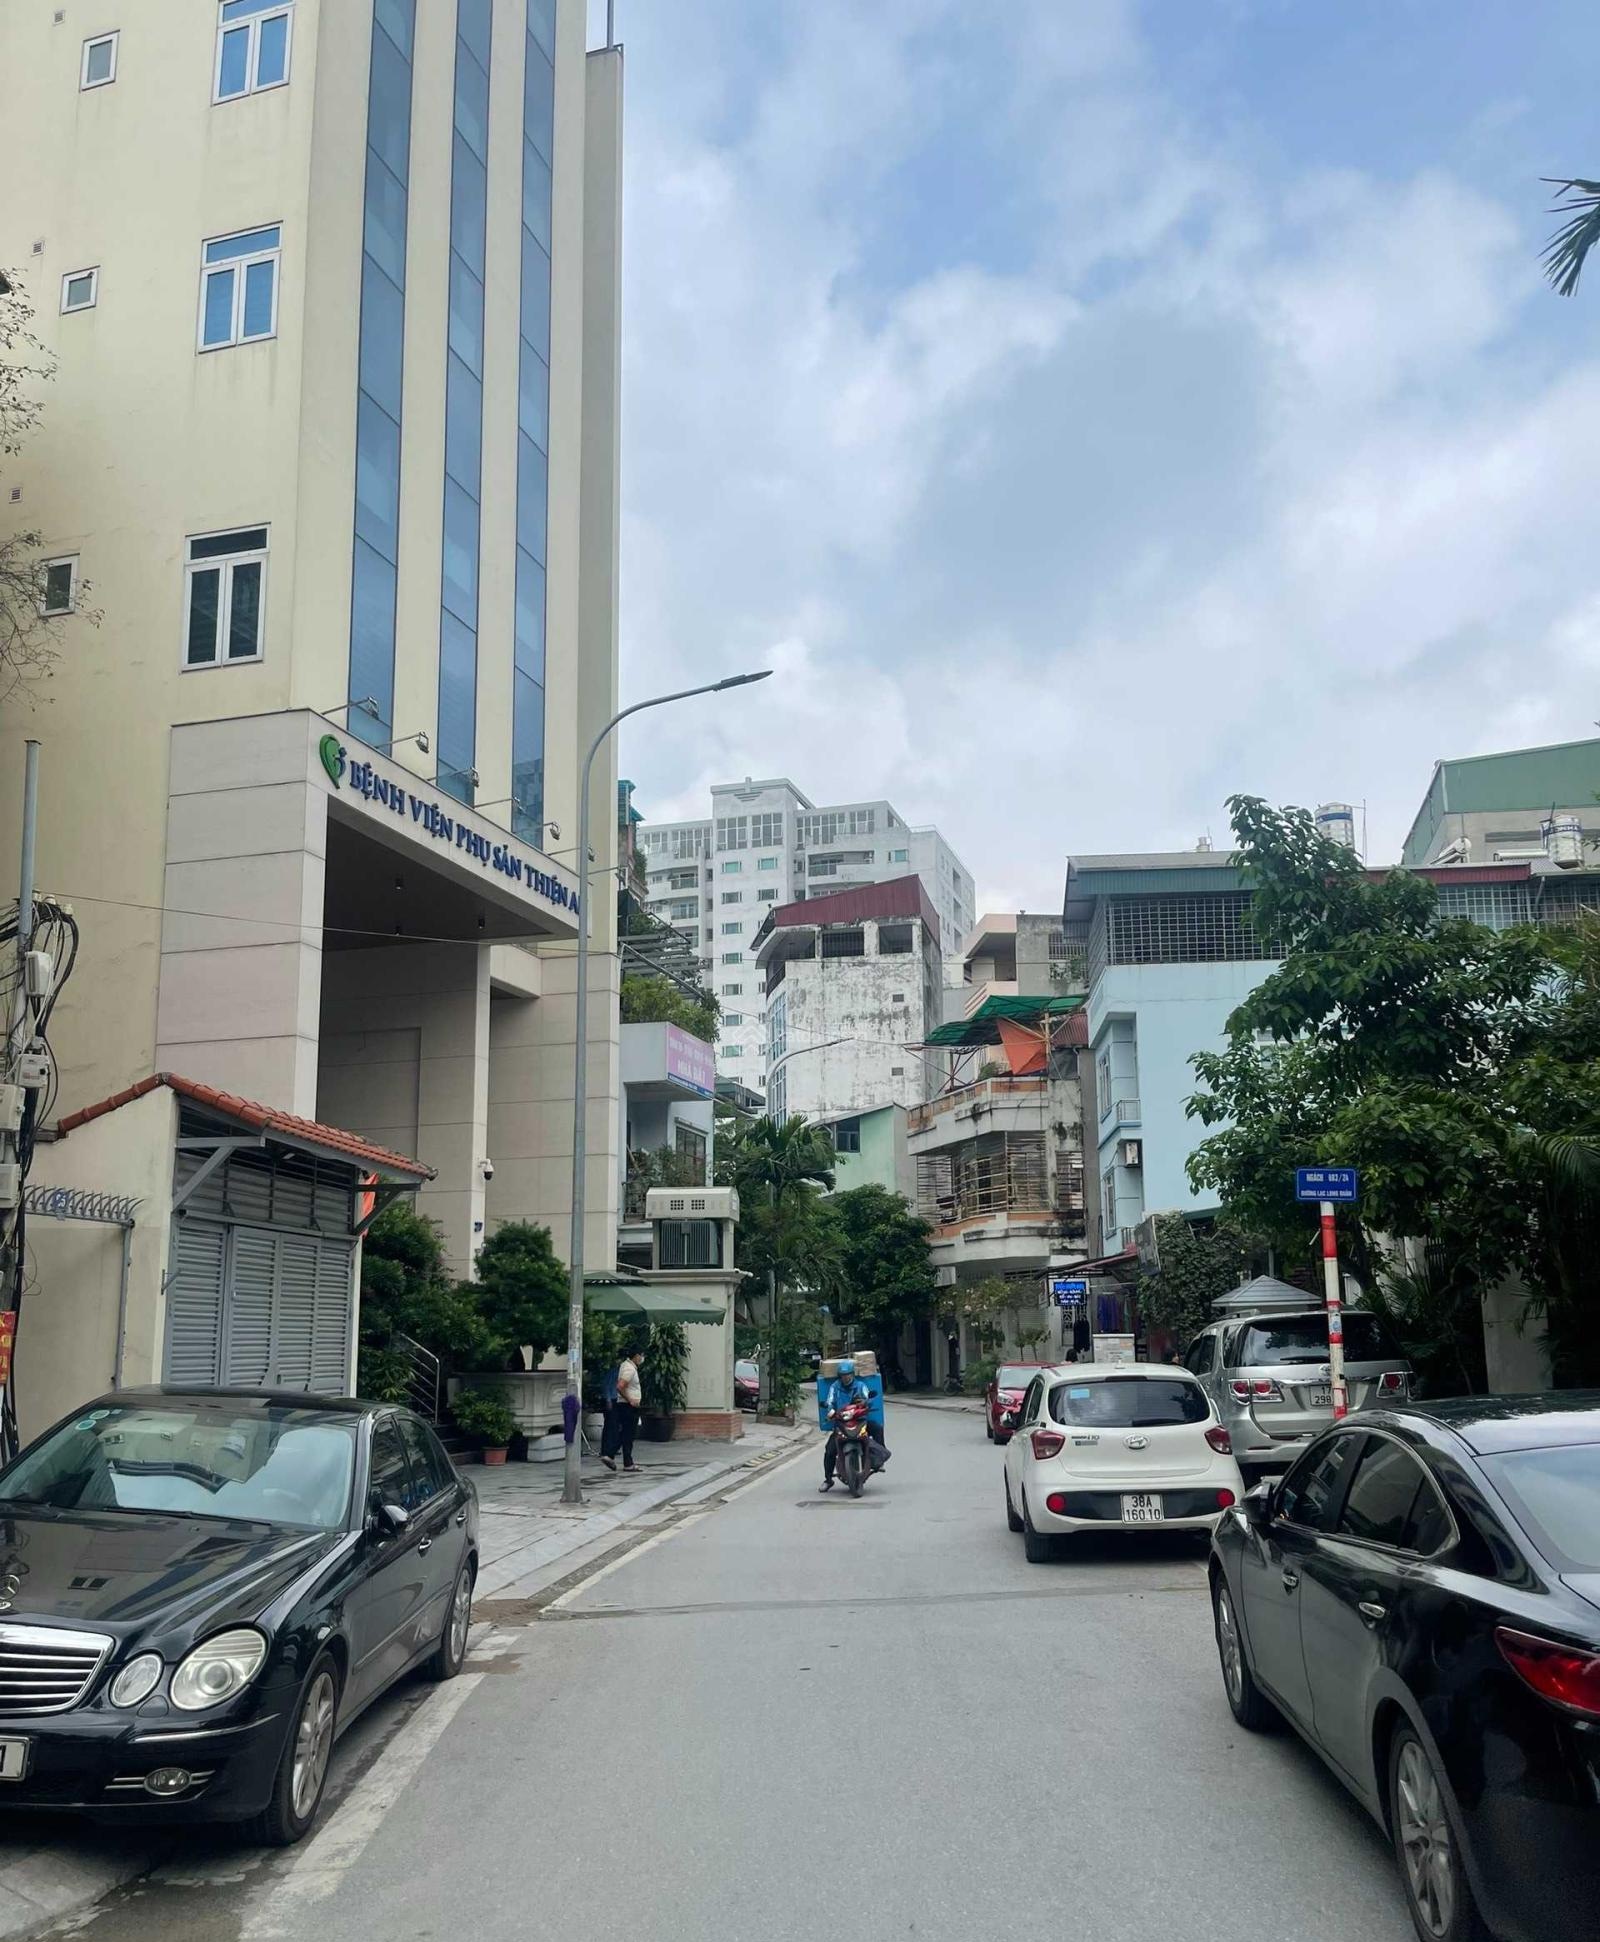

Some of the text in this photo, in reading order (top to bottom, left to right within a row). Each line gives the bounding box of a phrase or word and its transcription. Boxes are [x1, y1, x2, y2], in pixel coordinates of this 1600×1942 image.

[350, 760, 406, 815] BỆNH
[408, 795, 454, 841] VIỆN
[456, 823, 491, 867] PHỤ
[493, 844, 522, 881] SẢN
[525, 863, 569, 907] THIỆN
[1131, 1495, 1152, 1508] 38A
